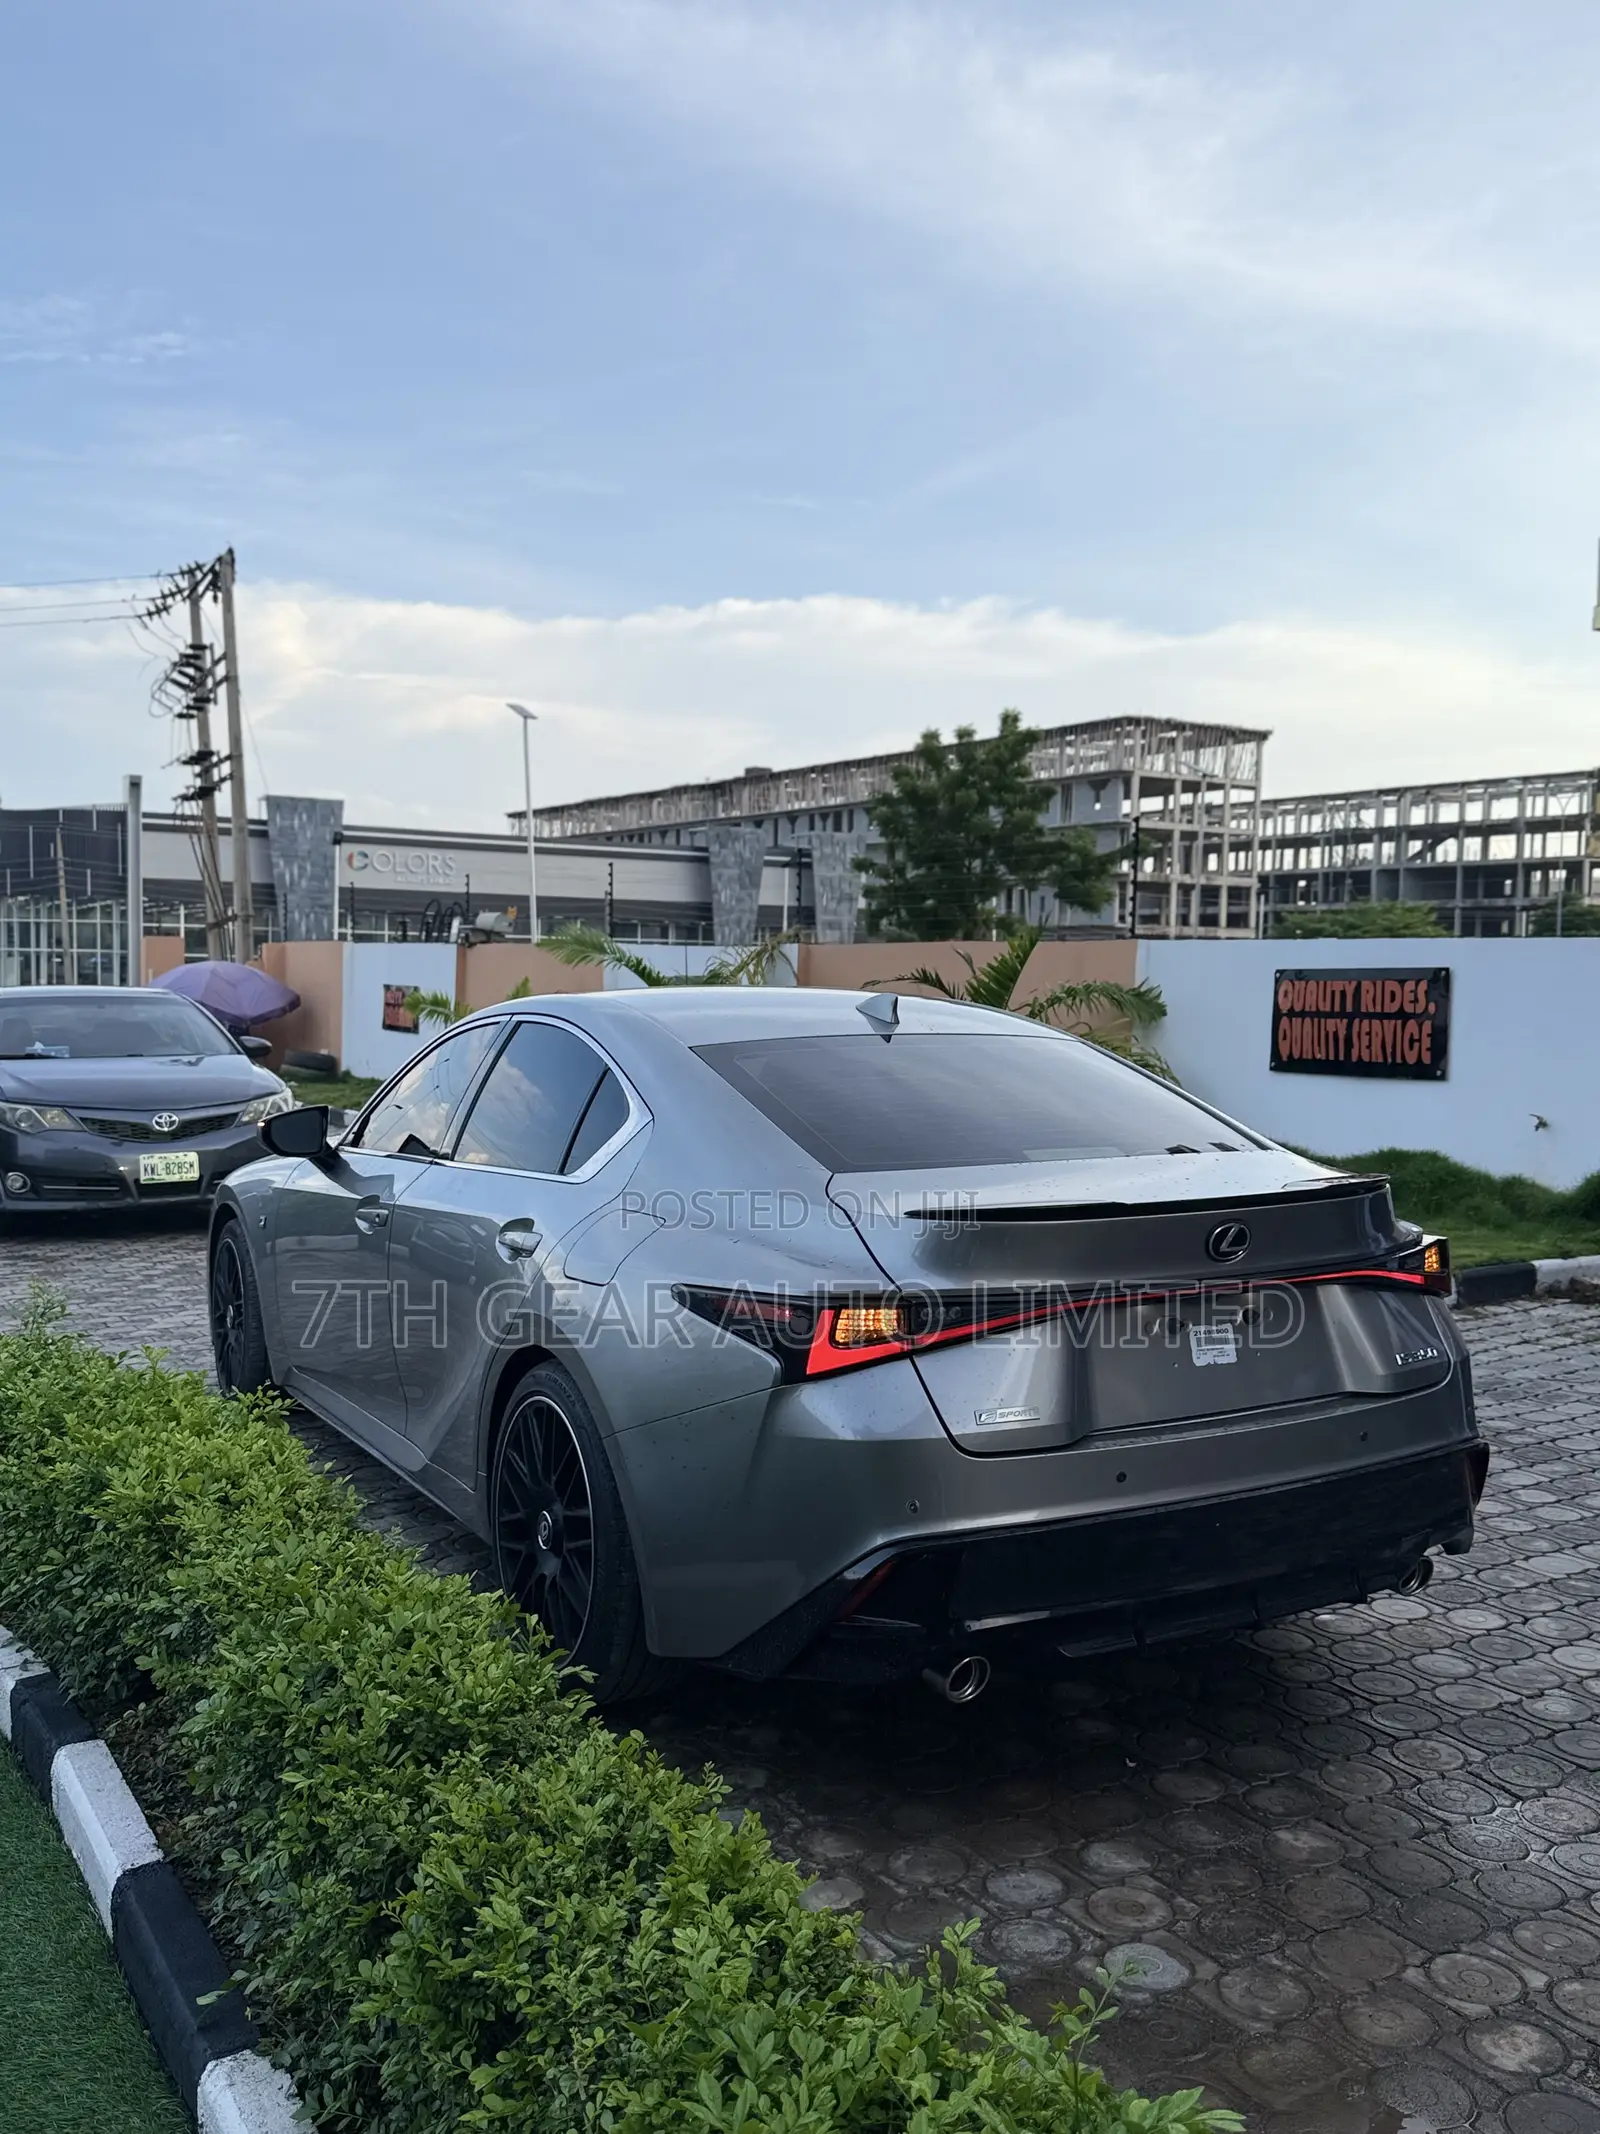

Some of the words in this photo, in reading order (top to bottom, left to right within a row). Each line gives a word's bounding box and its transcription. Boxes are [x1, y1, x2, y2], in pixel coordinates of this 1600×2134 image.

[347, 850, 456, 875] COLORS
[1278, 980, 1358, 1013] QUALITY
[1360, 980, 1436, 1014] RIDES.
[1278, 1016, 1348, 1061] QUALITY
[1351, 1018, 1432, 1065] SERVICE
